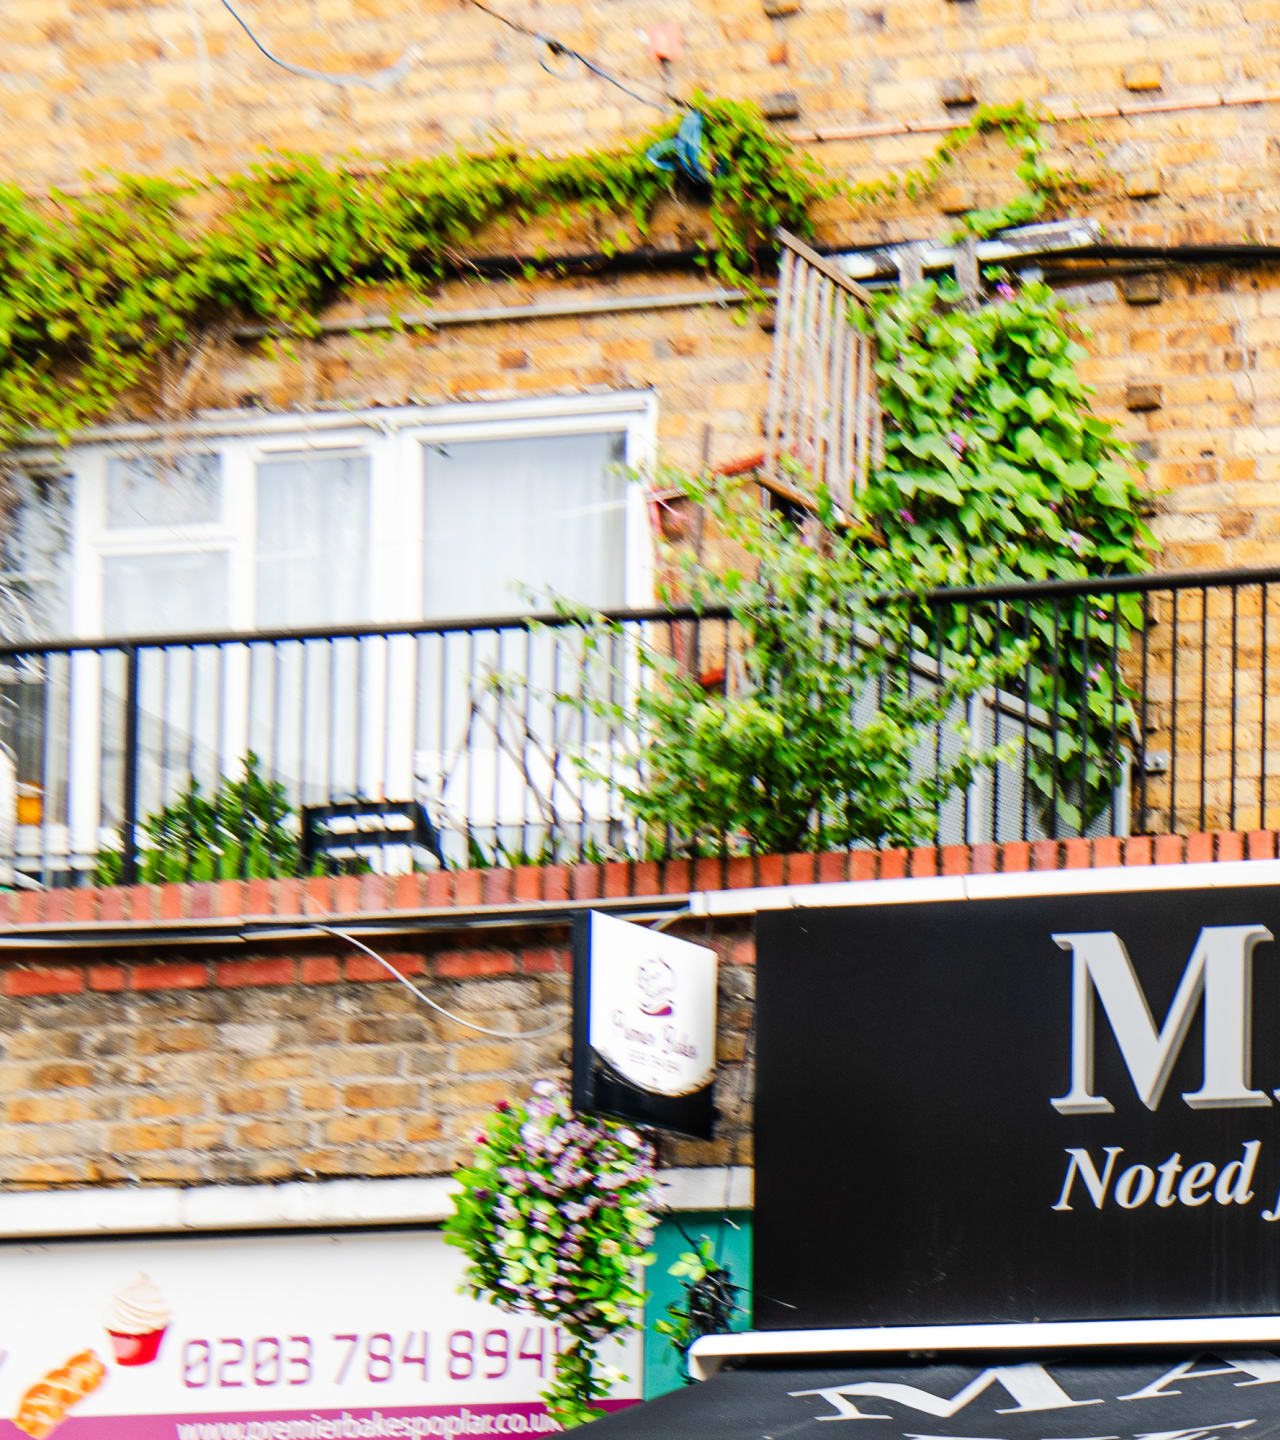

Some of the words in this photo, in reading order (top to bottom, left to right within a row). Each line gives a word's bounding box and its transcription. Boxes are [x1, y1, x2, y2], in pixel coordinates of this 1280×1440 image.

[1052, 1139, 1261, 1211] Noted
[183, 1335, 313, 1388] 0203
[332, 1330, 430, 1384] 784
